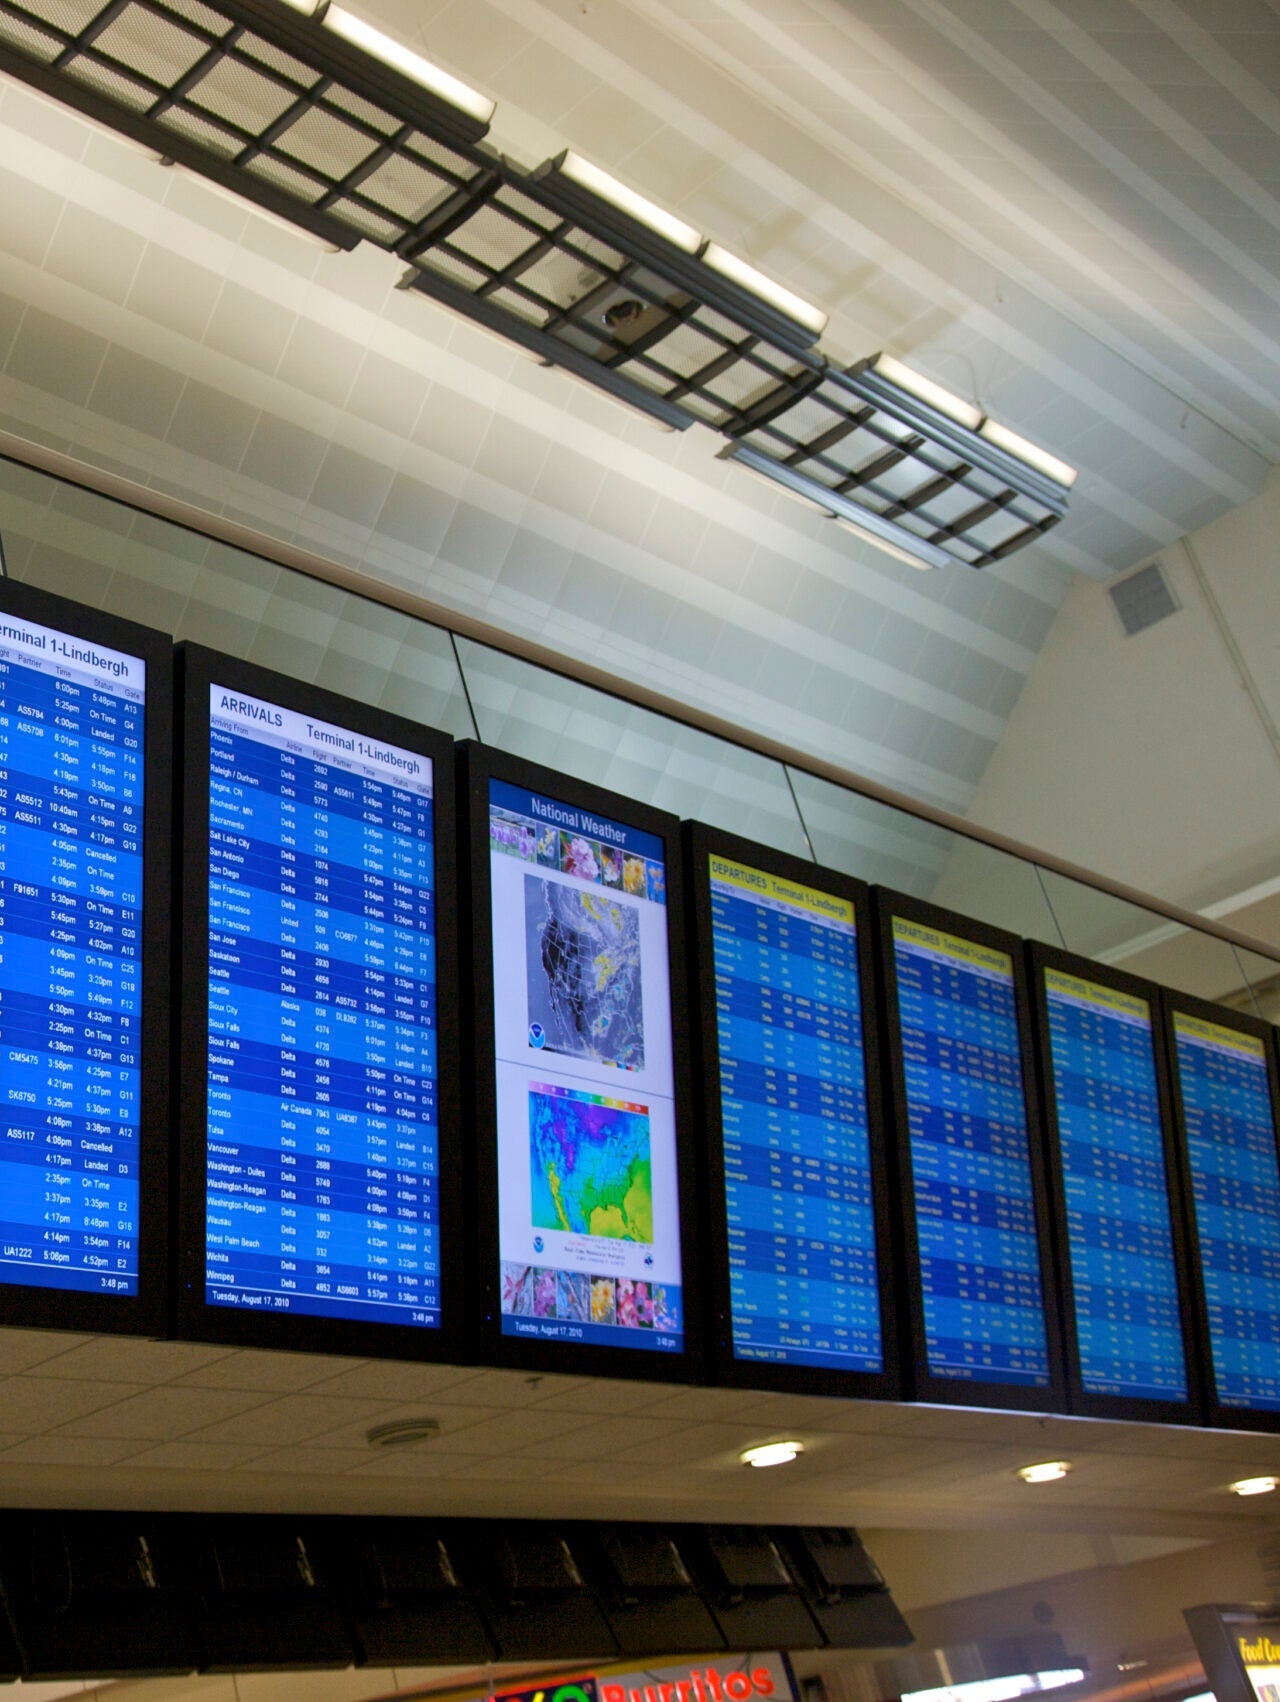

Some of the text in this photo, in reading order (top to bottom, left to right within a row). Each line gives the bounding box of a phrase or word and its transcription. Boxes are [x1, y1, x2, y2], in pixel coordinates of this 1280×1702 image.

[48, 636, 130, 679] 1-Lindbergh
[219, 693, 421, 776] ARRIVALS Terminal 1-Lindbergh
[530, 797, 627, 844] National Weather
[711, 860, 768, 889] DEPARTURES
[100, 1276, 117, 1288] 3:48
[116, 1280, 129, 1291] pm
[540, 1324, 559, 1337] August
